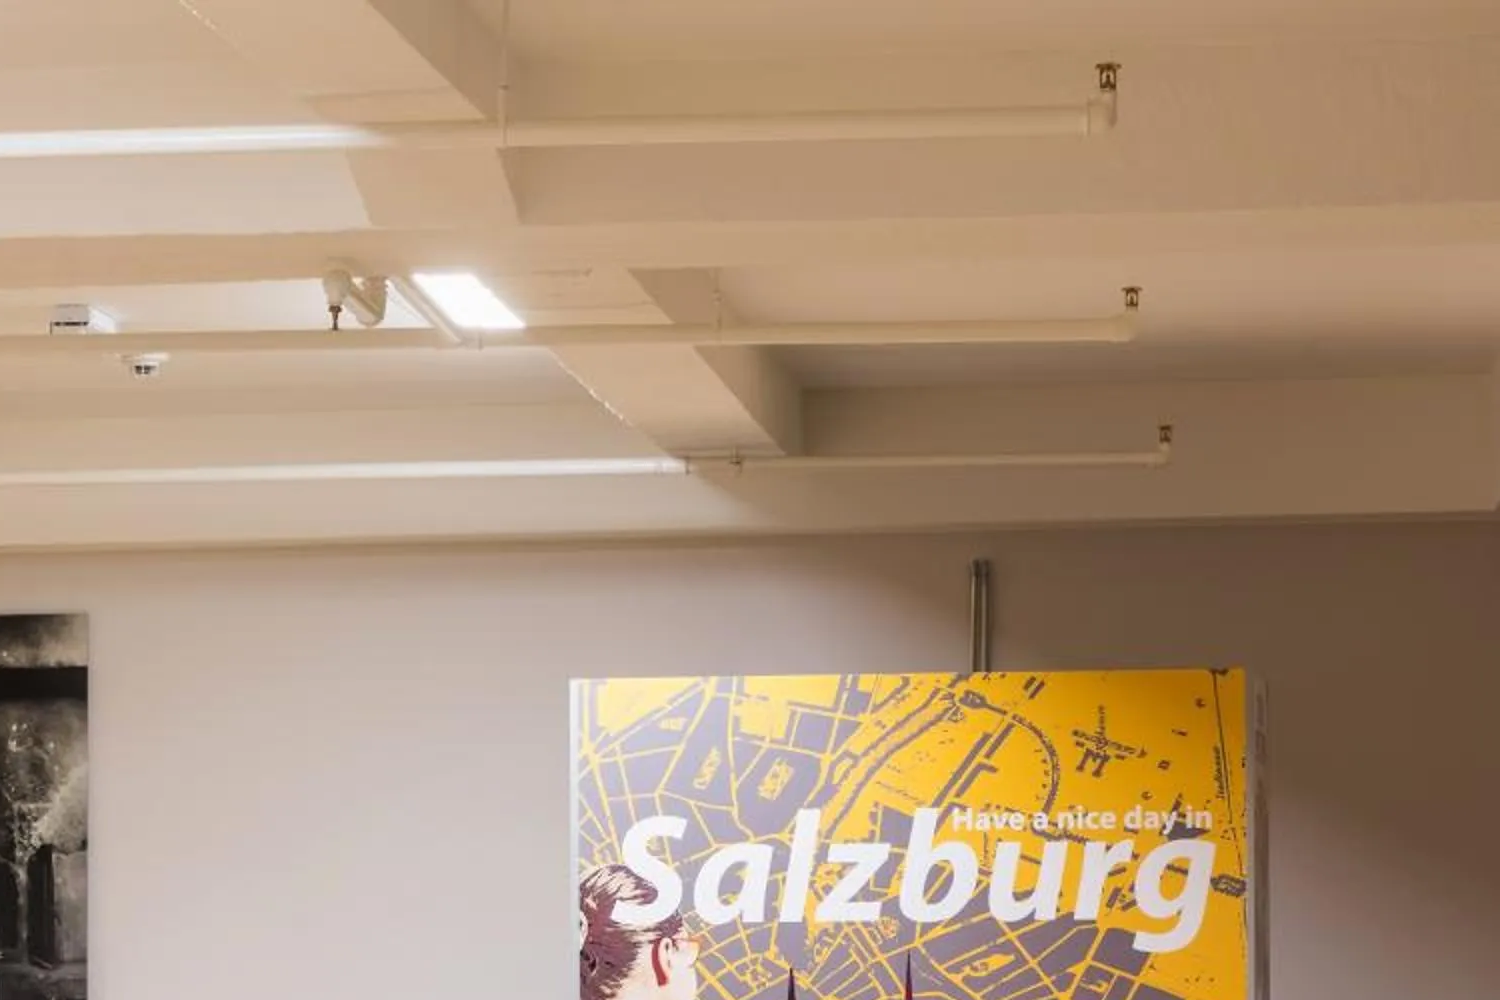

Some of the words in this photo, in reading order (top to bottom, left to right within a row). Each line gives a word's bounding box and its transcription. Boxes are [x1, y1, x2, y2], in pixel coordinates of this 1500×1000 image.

[952, 807, 1025, 832] Have
[1033, 812, 1050, 830] a
[1057, 804, 1117, 830] nice
[1124, 803, 1178, 835] day
[1185, 804, 1214, 830] in
[611, 807, 1216, 953] Salzburg
